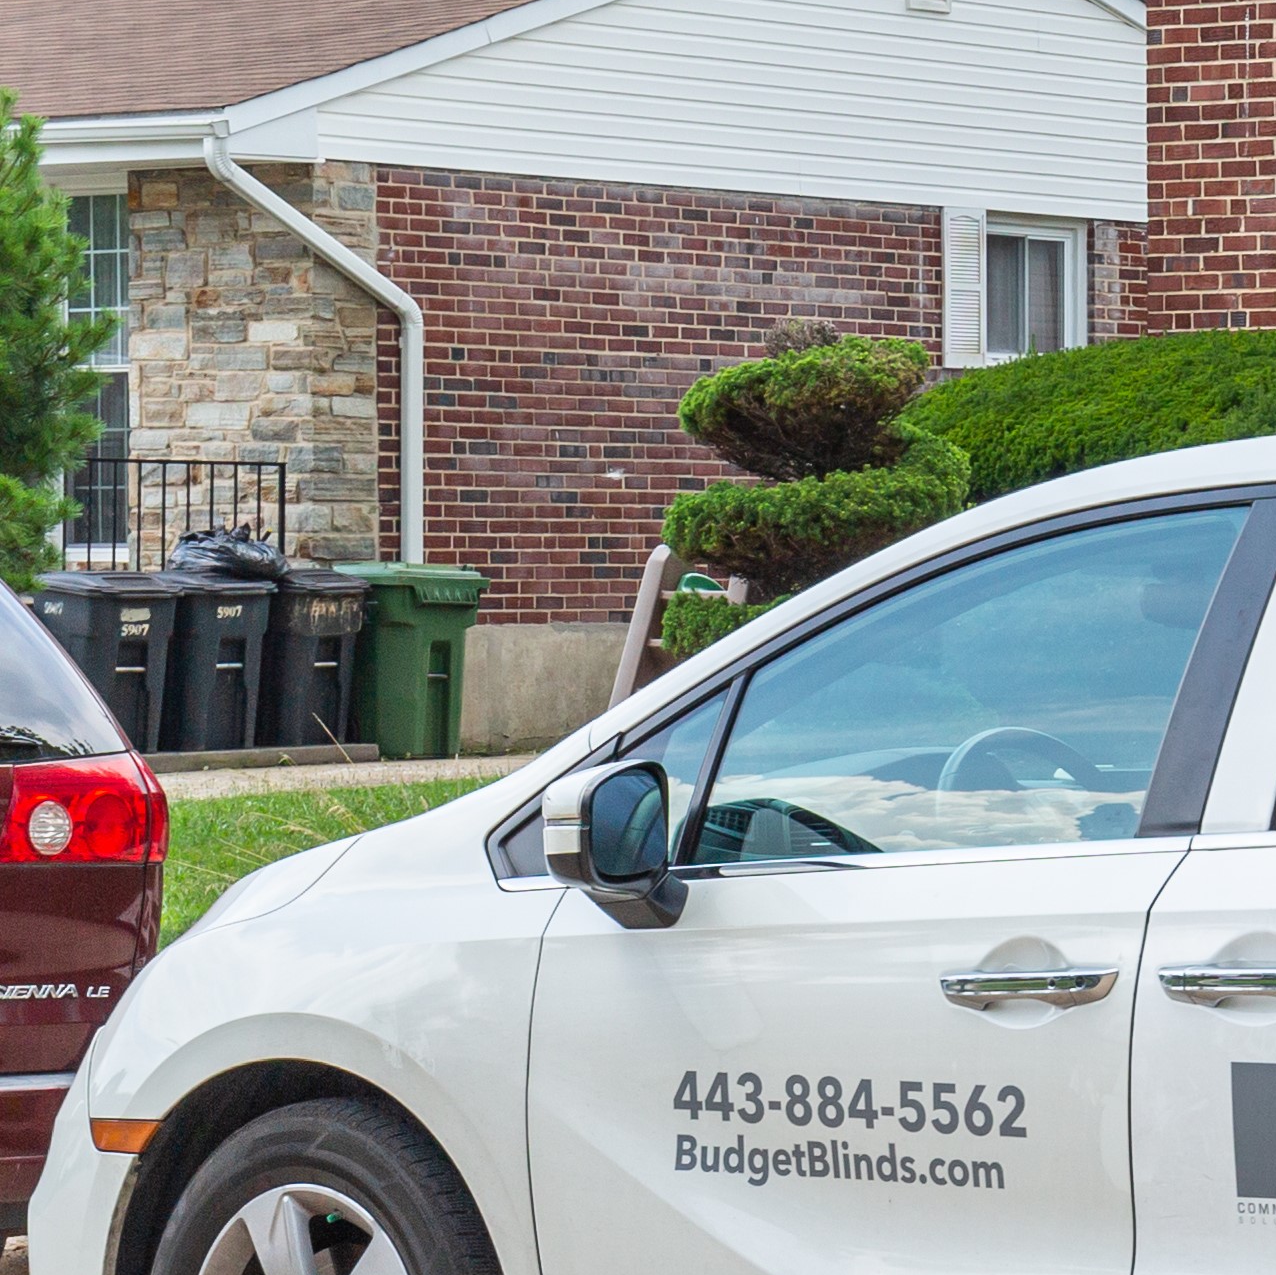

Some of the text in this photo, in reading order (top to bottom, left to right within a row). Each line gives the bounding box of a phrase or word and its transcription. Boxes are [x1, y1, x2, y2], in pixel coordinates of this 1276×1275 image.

[120, 623, 151, 637] 5907
[87, 985, 111, 999] LE
[673, 1070, 1028, 1139] 443-884-5562
[674, 1133, 1006, 1190] BudgetBlinds.com
